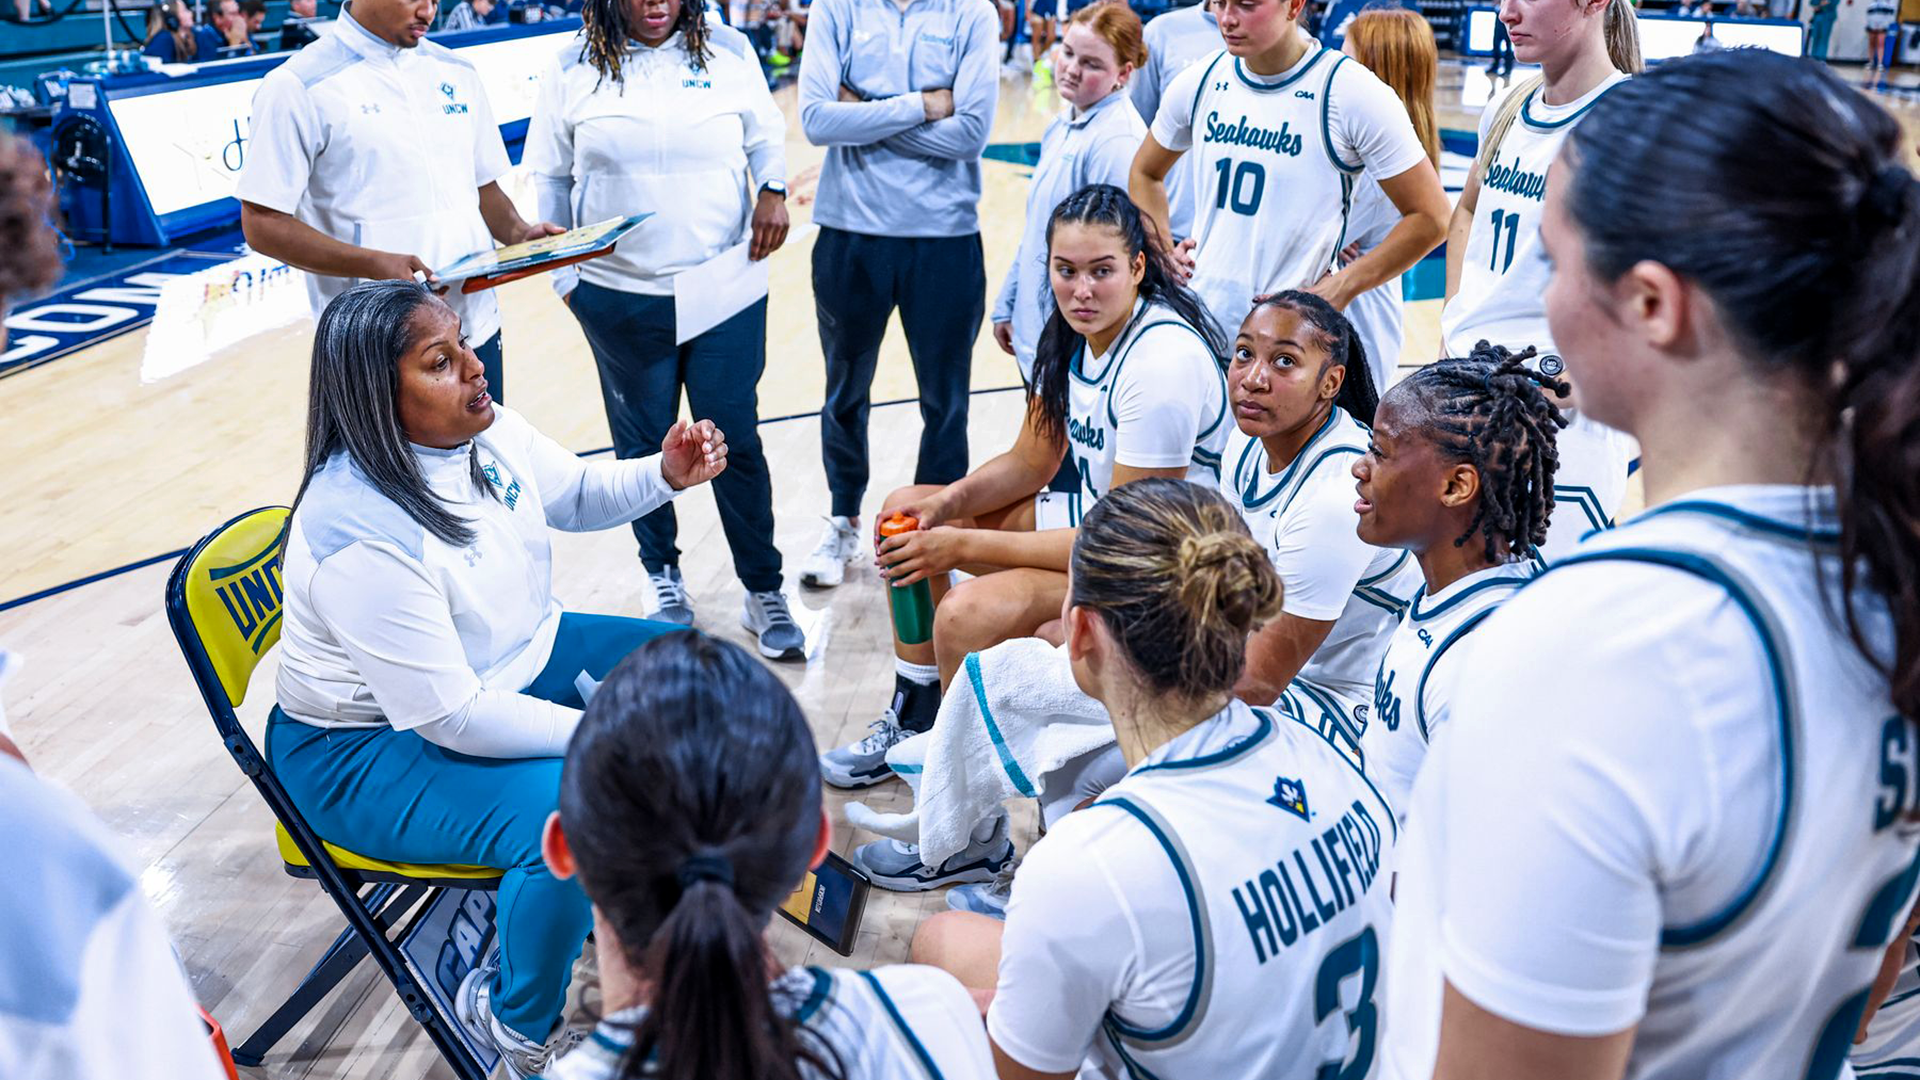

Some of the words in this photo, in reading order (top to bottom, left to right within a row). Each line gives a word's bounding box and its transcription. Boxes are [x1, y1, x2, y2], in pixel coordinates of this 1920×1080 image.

[682, 79, 711, 89] UNCW
[1294, 90, 1315, 100] CAA
[442, 103, 468, 114] UNCW
[1204, 111, 1302, 157] Seahawks
[1215, 157, 1266, 217] 10
[1491, 208, 1520, 275] 11
[503, 477, 522, 512] UNCW
[1231, 799, 1381, 965] HOLLIFIELD
[1313, 922, 1380, 1080] 3
